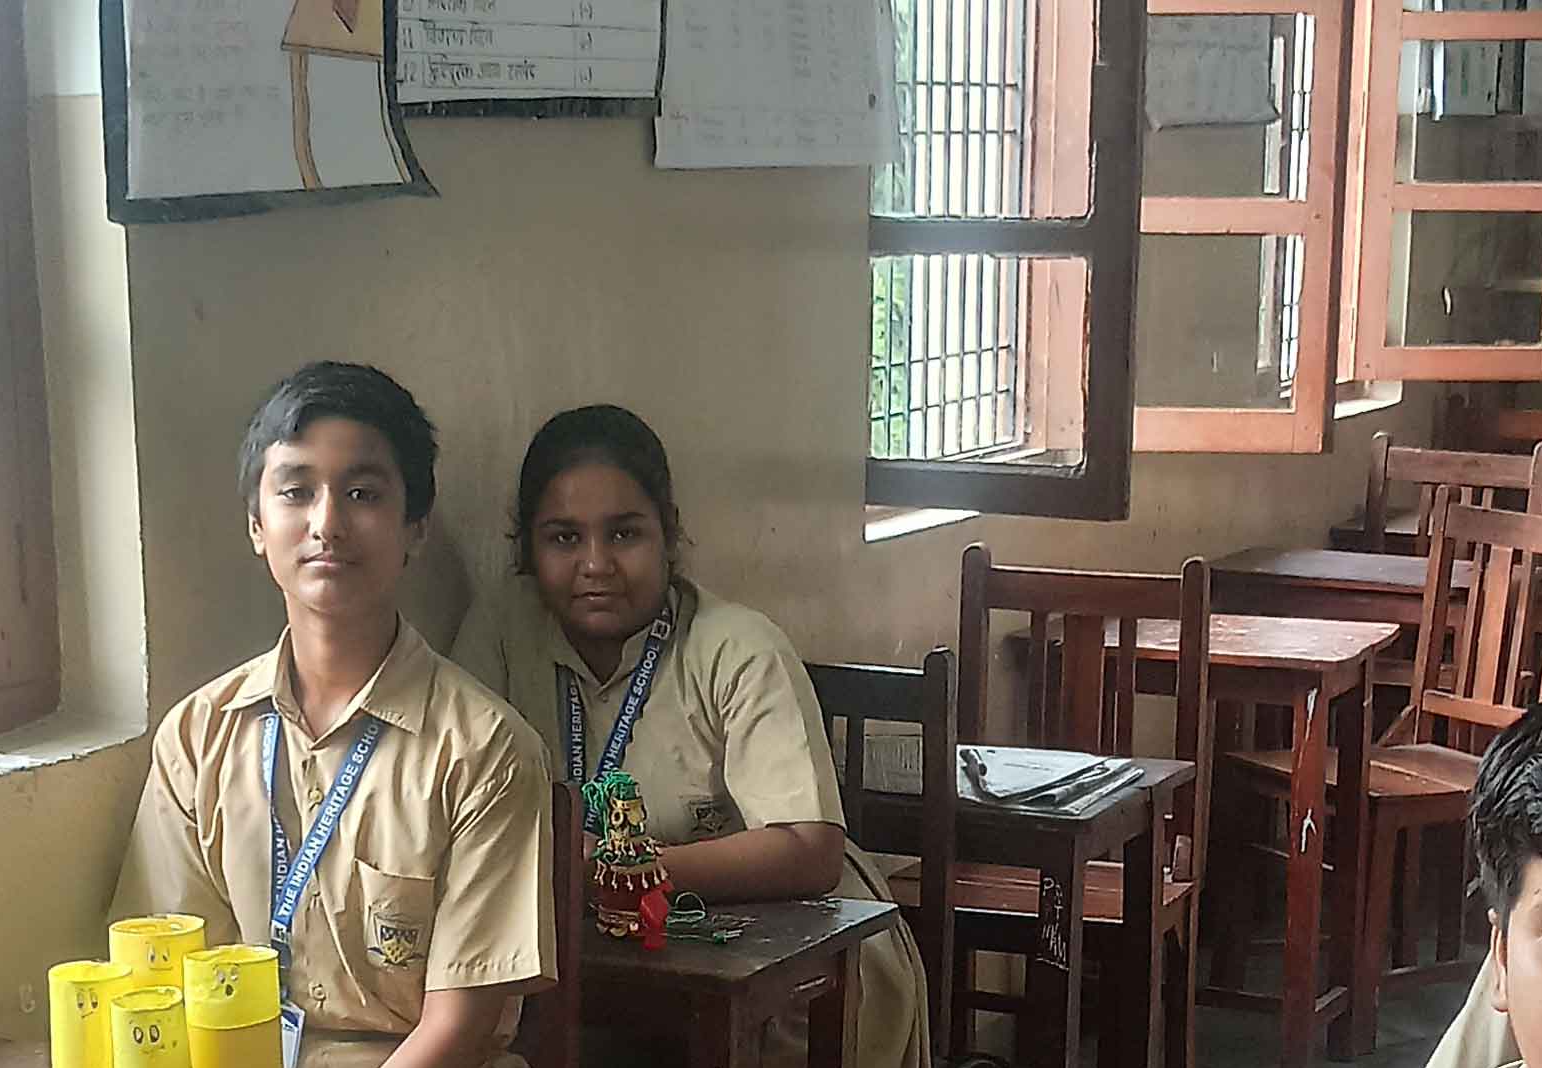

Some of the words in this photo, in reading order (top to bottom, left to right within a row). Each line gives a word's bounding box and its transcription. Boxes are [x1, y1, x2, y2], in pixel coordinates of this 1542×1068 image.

[609, 695, 640, 759] HERITAGE
[633, 645, 660, 696] SCHOOL
[278, 887, 298, 917] THE
[288, 836, 322, 889] INDIAN
[315, 763, 359, 841] HERITAGE
